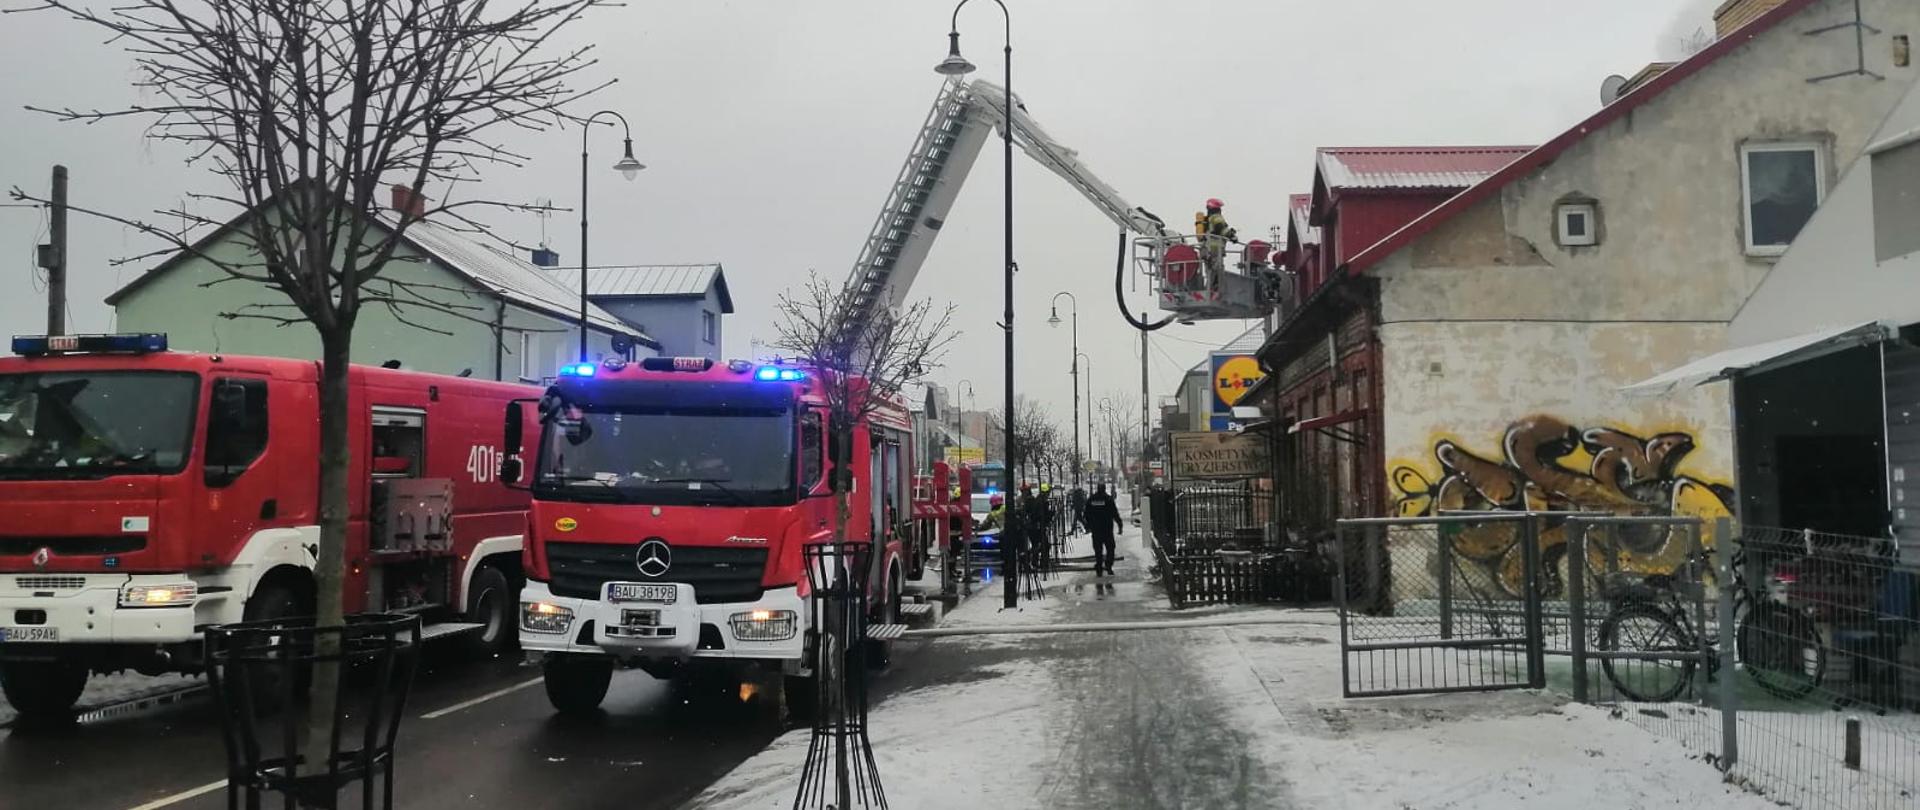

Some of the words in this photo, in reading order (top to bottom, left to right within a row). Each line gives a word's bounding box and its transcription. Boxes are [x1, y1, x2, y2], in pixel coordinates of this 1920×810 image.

[1184, 447, 1258, 461] KOSMETYKA
[466, 445, 495, 483] 401
[614, 586, 636, 598] BAU
[640, 586, 674, 599] 38198
[7, 628, 28, 640] BAU
